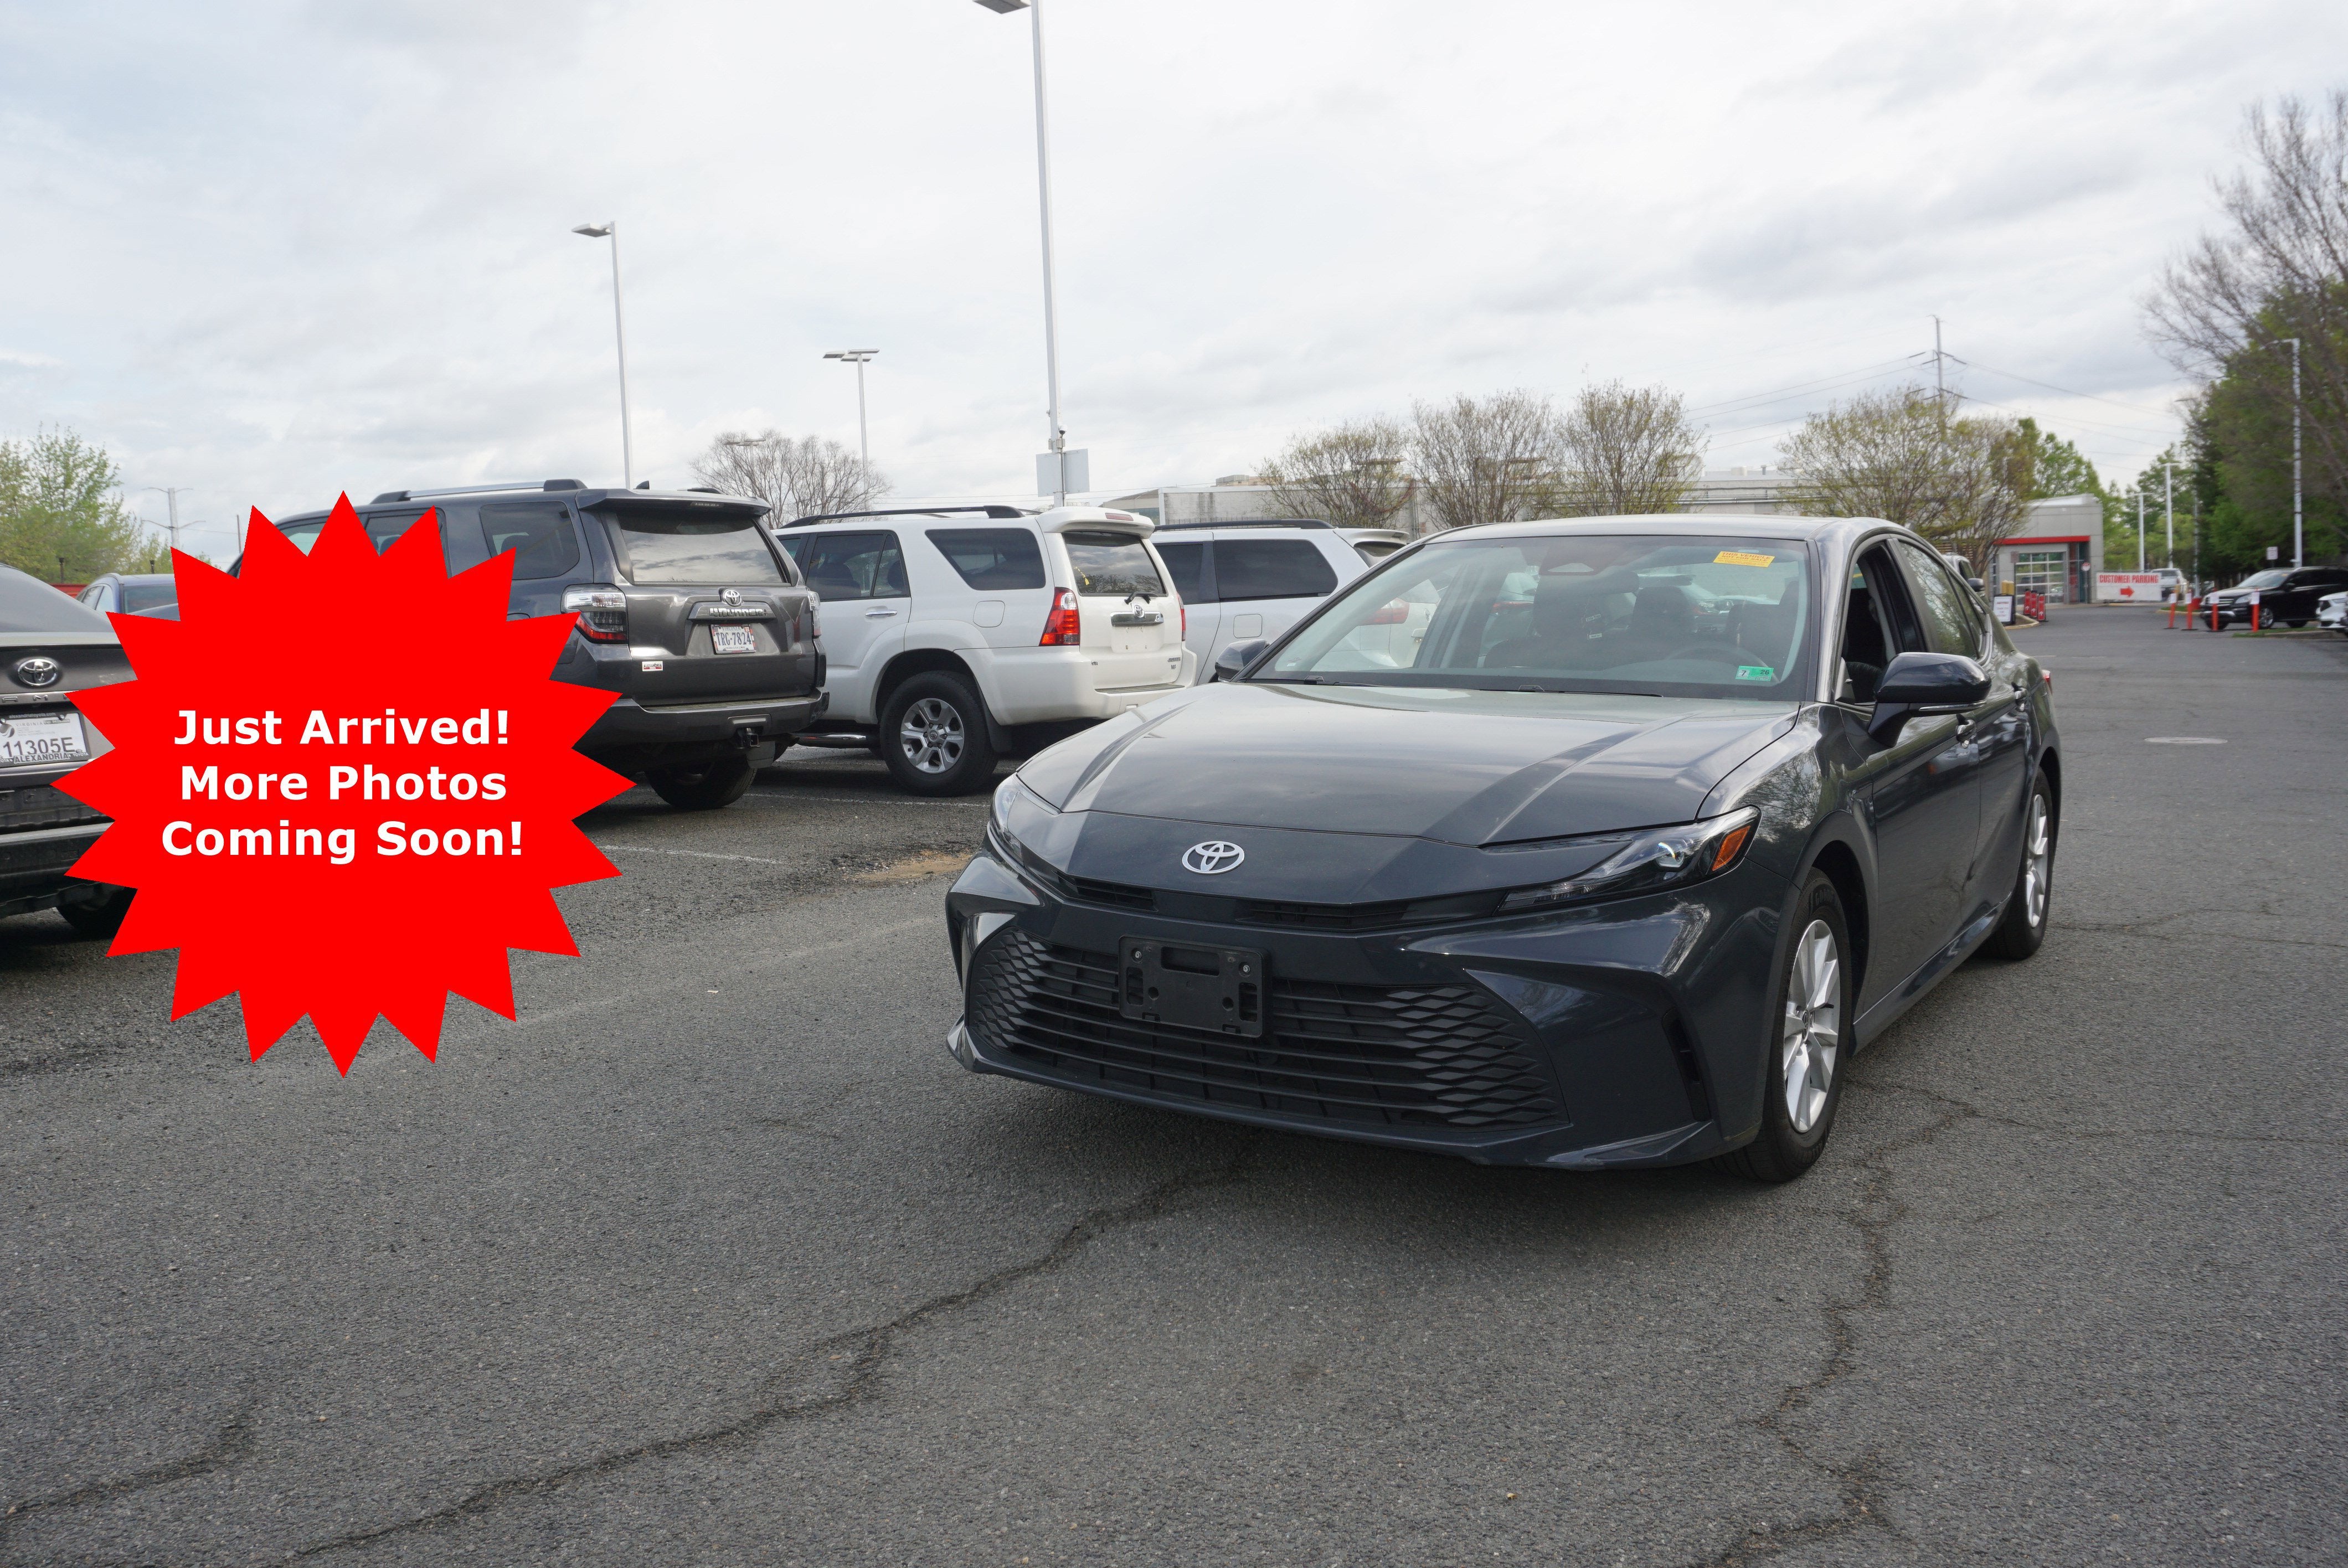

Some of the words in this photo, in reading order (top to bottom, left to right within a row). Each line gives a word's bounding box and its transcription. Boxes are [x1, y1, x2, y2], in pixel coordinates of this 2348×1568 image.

[2099, 574, 2130, 584] CUSTOMER
[2132, 574, 2159, 583] PARKING
[3, 737, 75, 757] 11305E
[14, 752, 70, 764] ALEXANDRIA
